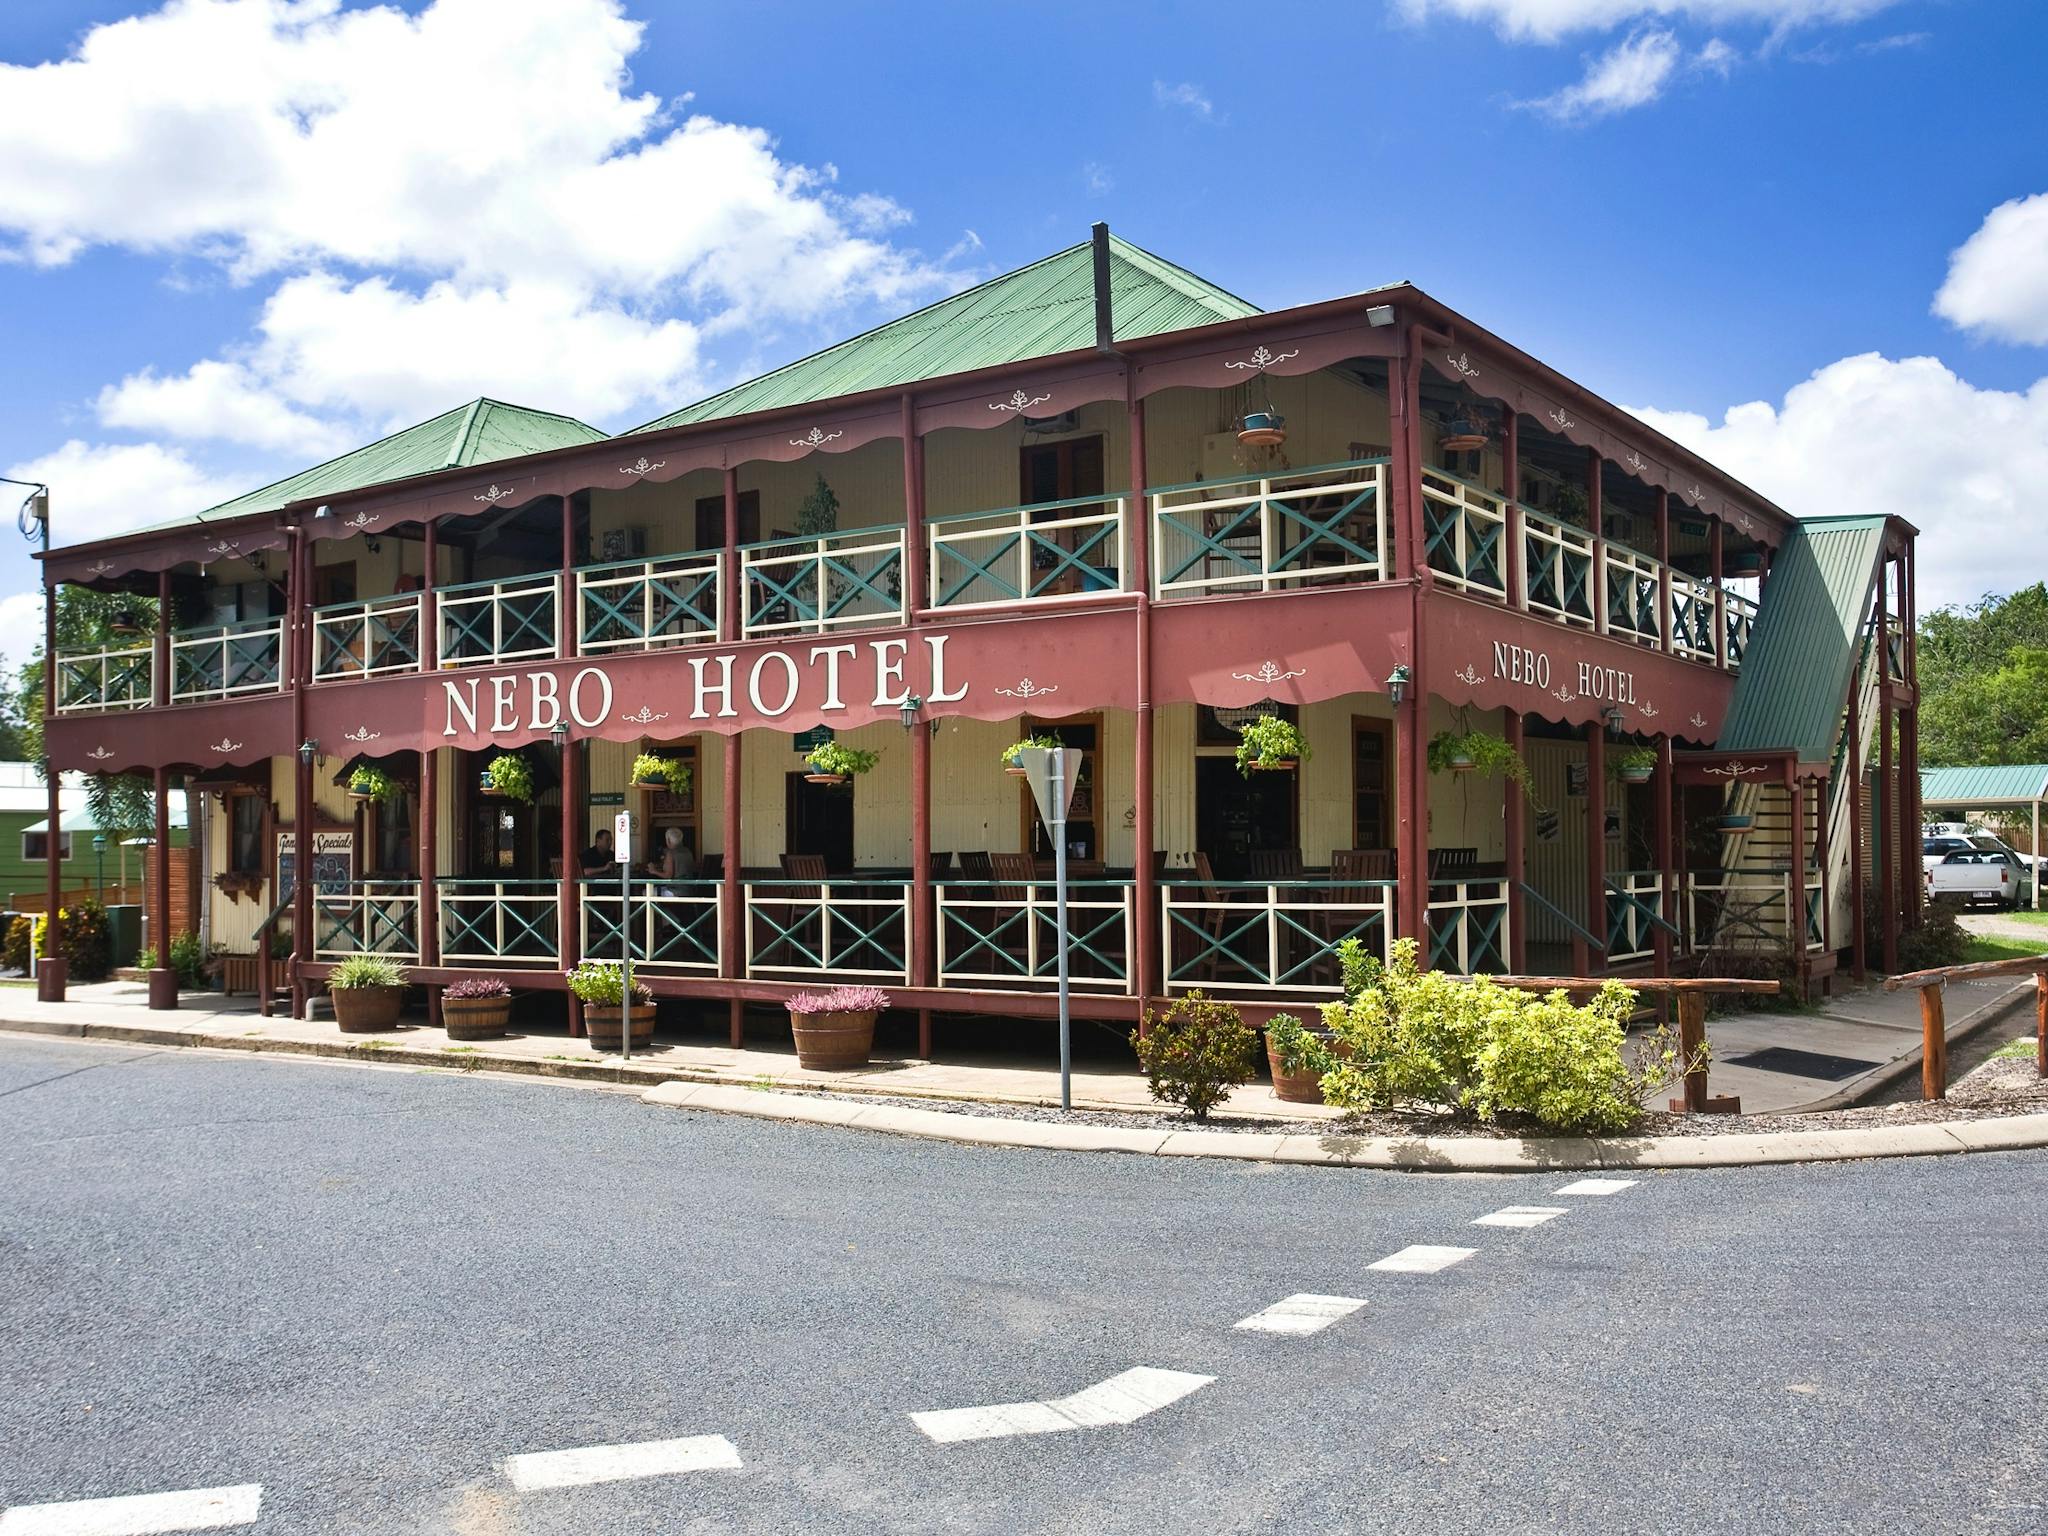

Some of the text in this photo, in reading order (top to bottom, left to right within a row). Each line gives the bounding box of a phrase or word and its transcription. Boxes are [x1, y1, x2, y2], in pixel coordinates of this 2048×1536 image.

[442, 634, 969, 737] NEBO HOTEL
[1493, 640, 1637, 705] NEBO HOTEL
[317, 834, 353, 855] Specials
